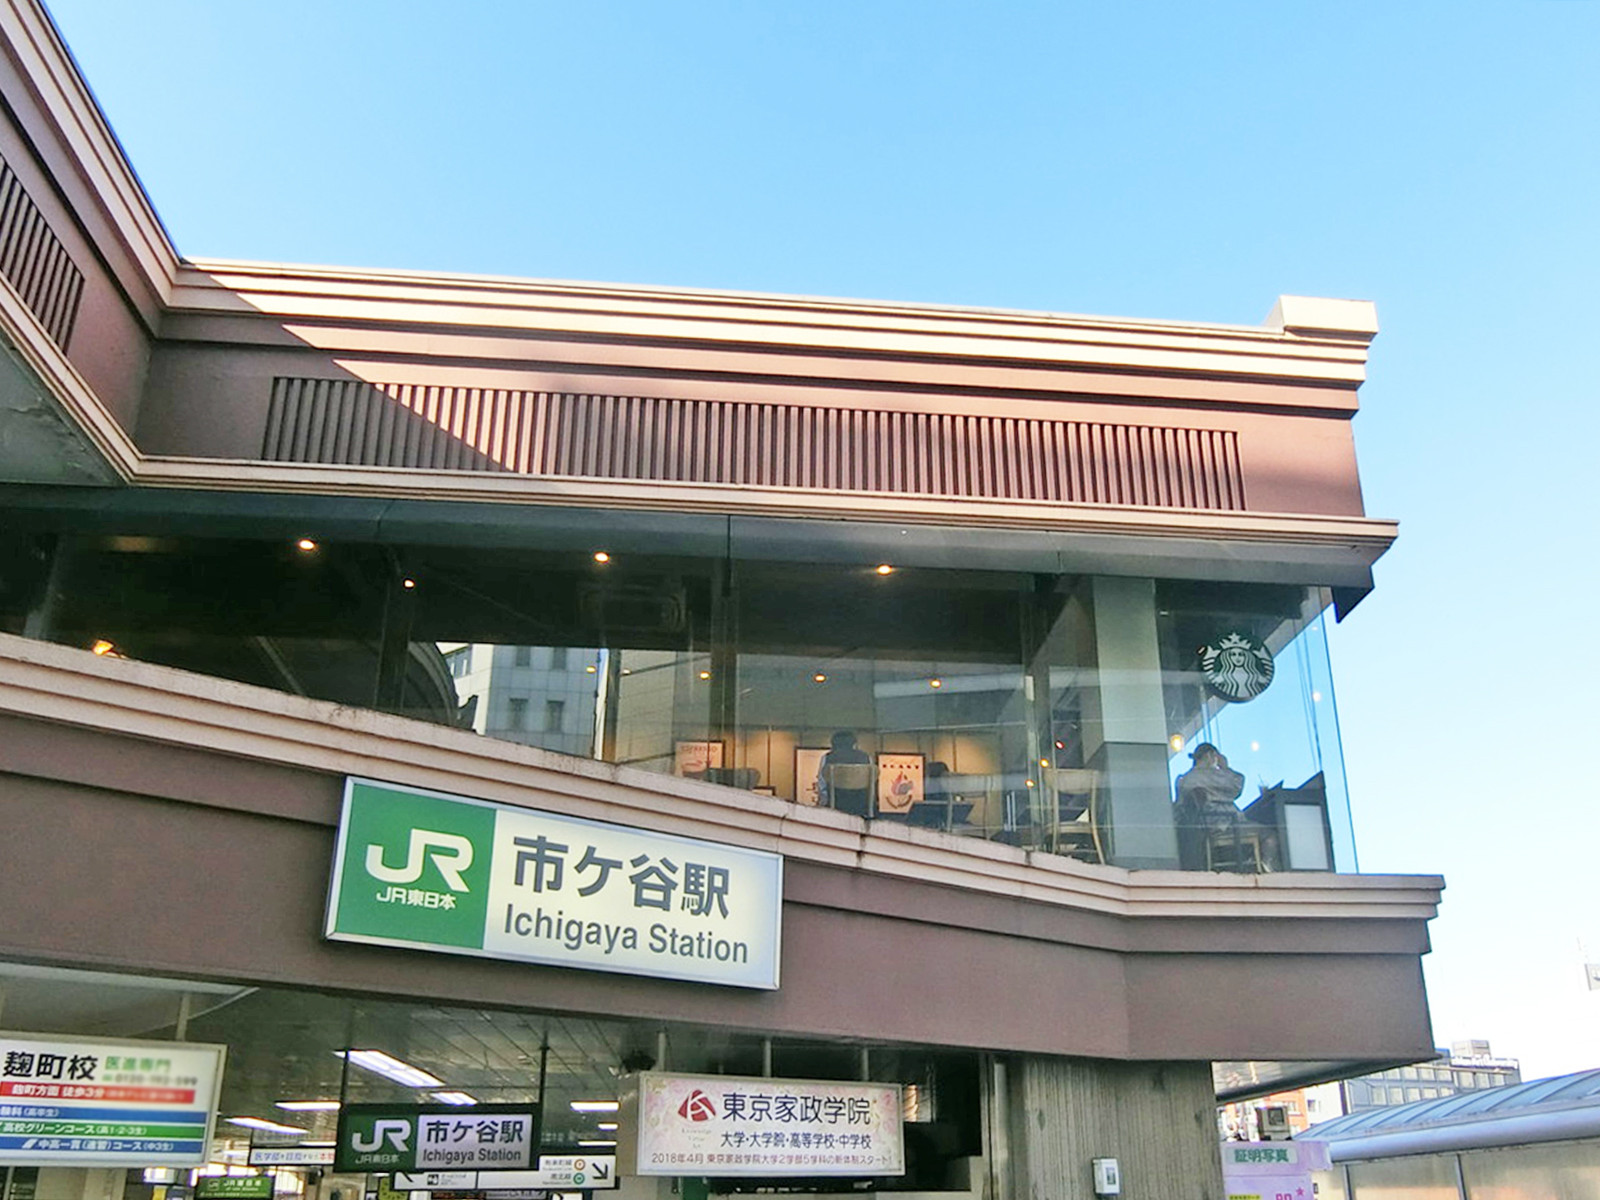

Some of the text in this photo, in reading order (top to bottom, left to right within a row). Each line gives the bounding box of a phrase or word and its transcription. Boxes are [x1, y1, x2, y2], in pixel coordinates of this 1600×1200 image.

[366, 828, 474, 893] JR
[513, 835, 730, 919] 市ケ谷駅
[376, 886, 457, 910] JR東日本
[504, 903, 748, 963] Ichigaya Station
[2, 1051, 99, 1081] 麹町校
[722, 1092, 871, 1125] 東京家政学院
[352, 1119, 412, 1152] JR
[426, 1120, 524, 1144] 市ケ谷駅
[355, 1154, 400, 1164] JR東日本
[423, 1149, 521, 1165] Ichigaya Station
[652, 1153, 705, 1165] 2018年4月
